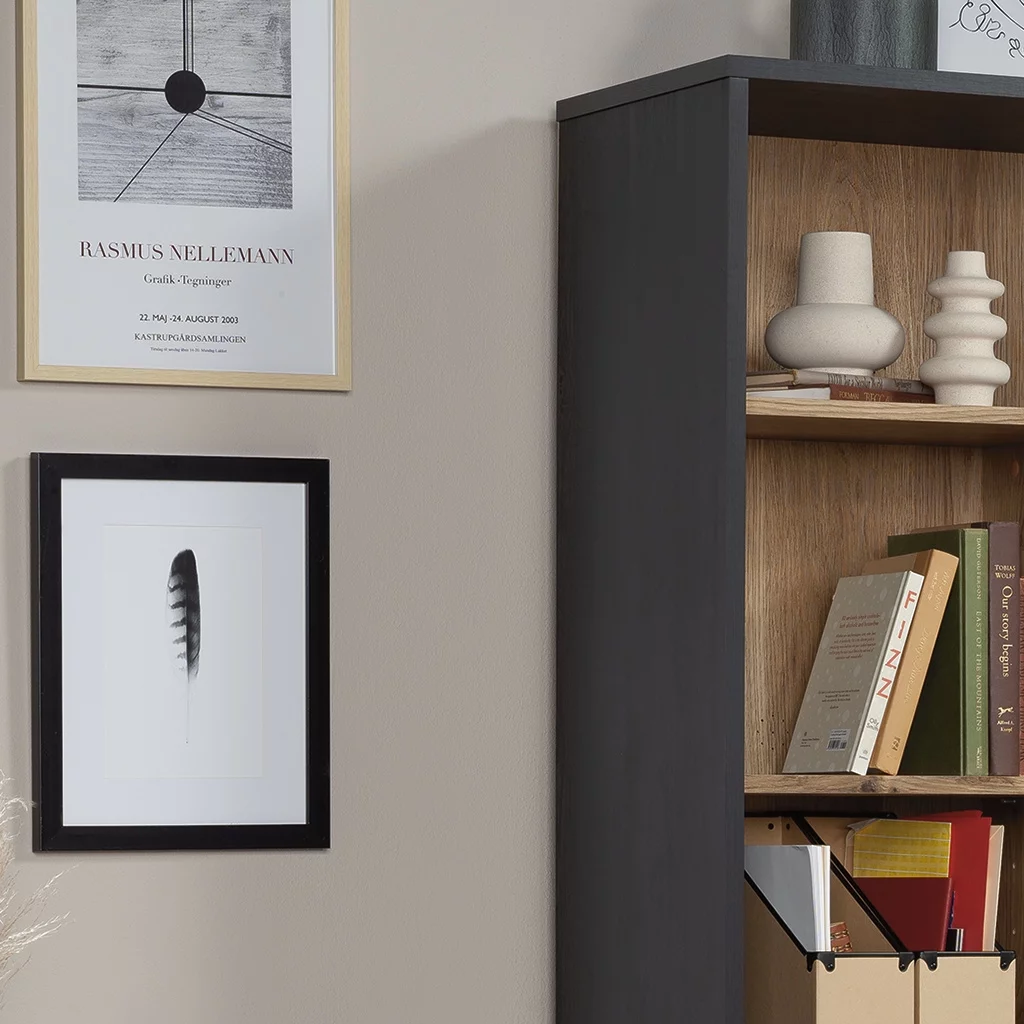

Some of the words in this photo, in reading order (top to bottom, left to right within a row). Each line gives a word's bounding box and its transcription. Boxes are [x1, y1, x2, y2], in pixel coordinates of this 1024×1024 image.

[78, 241, 164, 261] RASMUS
[169, 244, 296, 265] NELLEMANN
[143, 273, 176, 285] Grafik
[139, 313, 151, 323] 22.
[152, 314, 168, 324] MAJ
[185, 315, 219, 325] AUGUST
[221, 315, 240, 325] 2003
[134, 332, 247, 345] KASTRUPGÅRDSAMLINGEN
[1002, 585, 1014, 606] Our
[999, 613, 1009, 641] story
[999, 645, 1013, 677] begins
